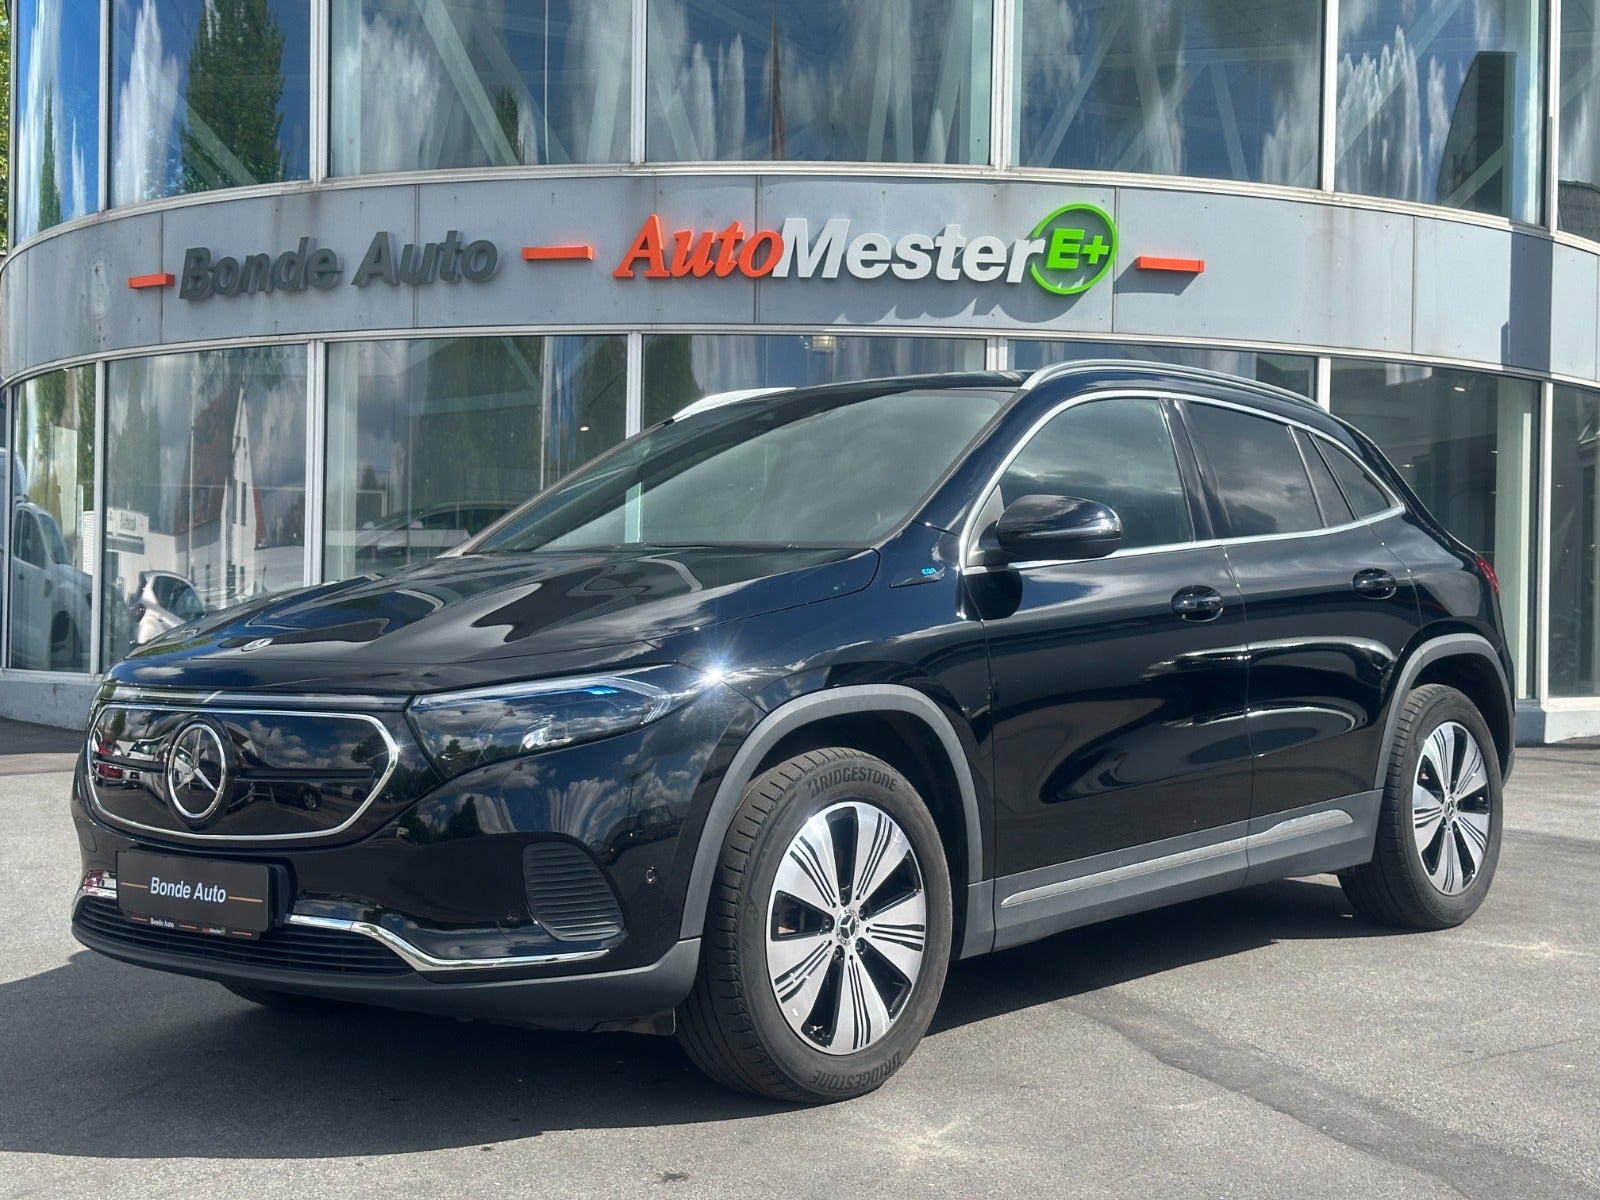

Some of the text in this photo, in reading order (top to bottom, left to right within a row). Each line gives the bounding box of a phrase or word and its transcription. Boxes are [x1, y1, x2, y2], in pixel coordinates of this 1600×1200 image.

[179, 229, 499, 300] Bonde Auto
[612, 213, 1109, 284] AutoMester E+
[807, 766, 898, 799] BRIDGESTONE
[150, 876, 227, 903] Bonde Auto
